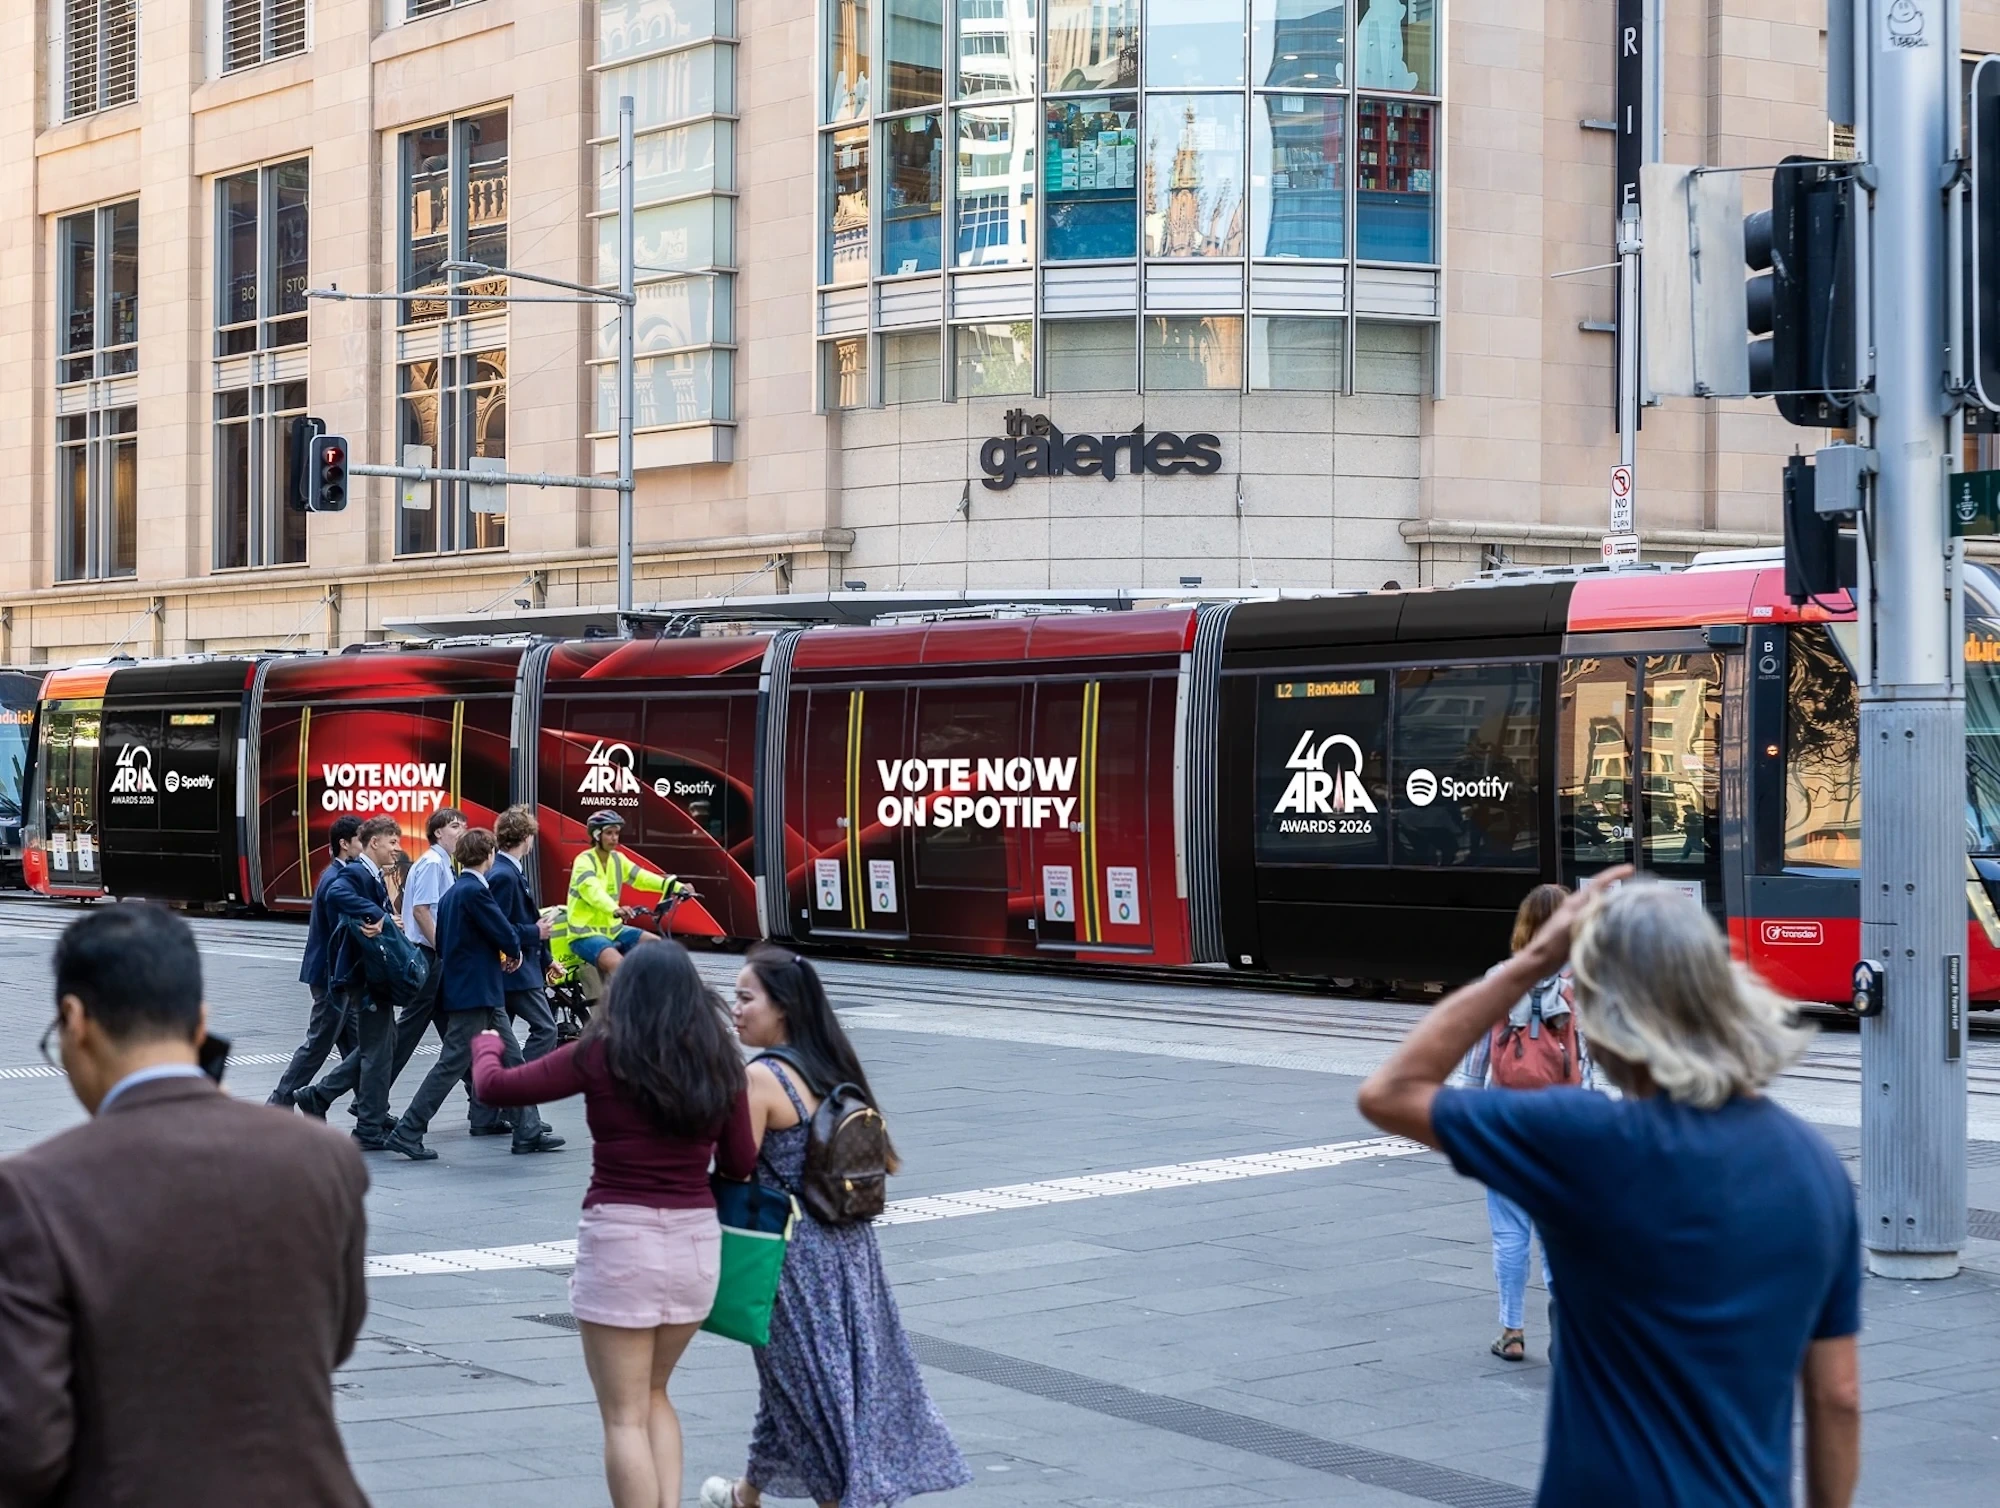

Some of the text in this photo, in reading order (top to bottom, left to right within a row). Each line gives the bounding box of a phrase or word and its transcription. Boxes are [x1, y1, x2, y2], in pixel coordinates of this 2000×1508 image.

[1003, 408, 1050, 436] the
[980, 422, 1222, 491] galeries
[1613, 510, 1628, 519] LEFT
[1615, 498, 1627, 509] NO
[1613, 520, 1629, 528] TURN
[1763, 641, 1774, 653] B
[1277, 681, 1361, 698] L2 Randwick
[115, 742, 152, 770] 40
[585, 740, 635, 771] 40
[1285, 730, 1363, 777] 40
[109, 767, 158, 793] ARIA
[181, 775, 215, 790] Spotify
[322, 763, 447, 788] VOTE NOW
[577, 766, 640, 793] ARIA
[876, 757, 1078, 792] VOTE NOW
[111, 795, 155, 805] AWARDS 2026
[673, 780, 716, 796] Spotify
[1273, 770, 1379, 815] ARIA
[1441, 776, 1510, 801] Spotify
[321, 789, 446, 812] ON SPOTIFY
[580, 796, 639, 807] AWARDS 2026
[877, 796, 1078, 829] ON SPOTIFY
[1279, 819, 1372, 834] AWARDS 2026
[1781, 930, 1818, 938] transdev
